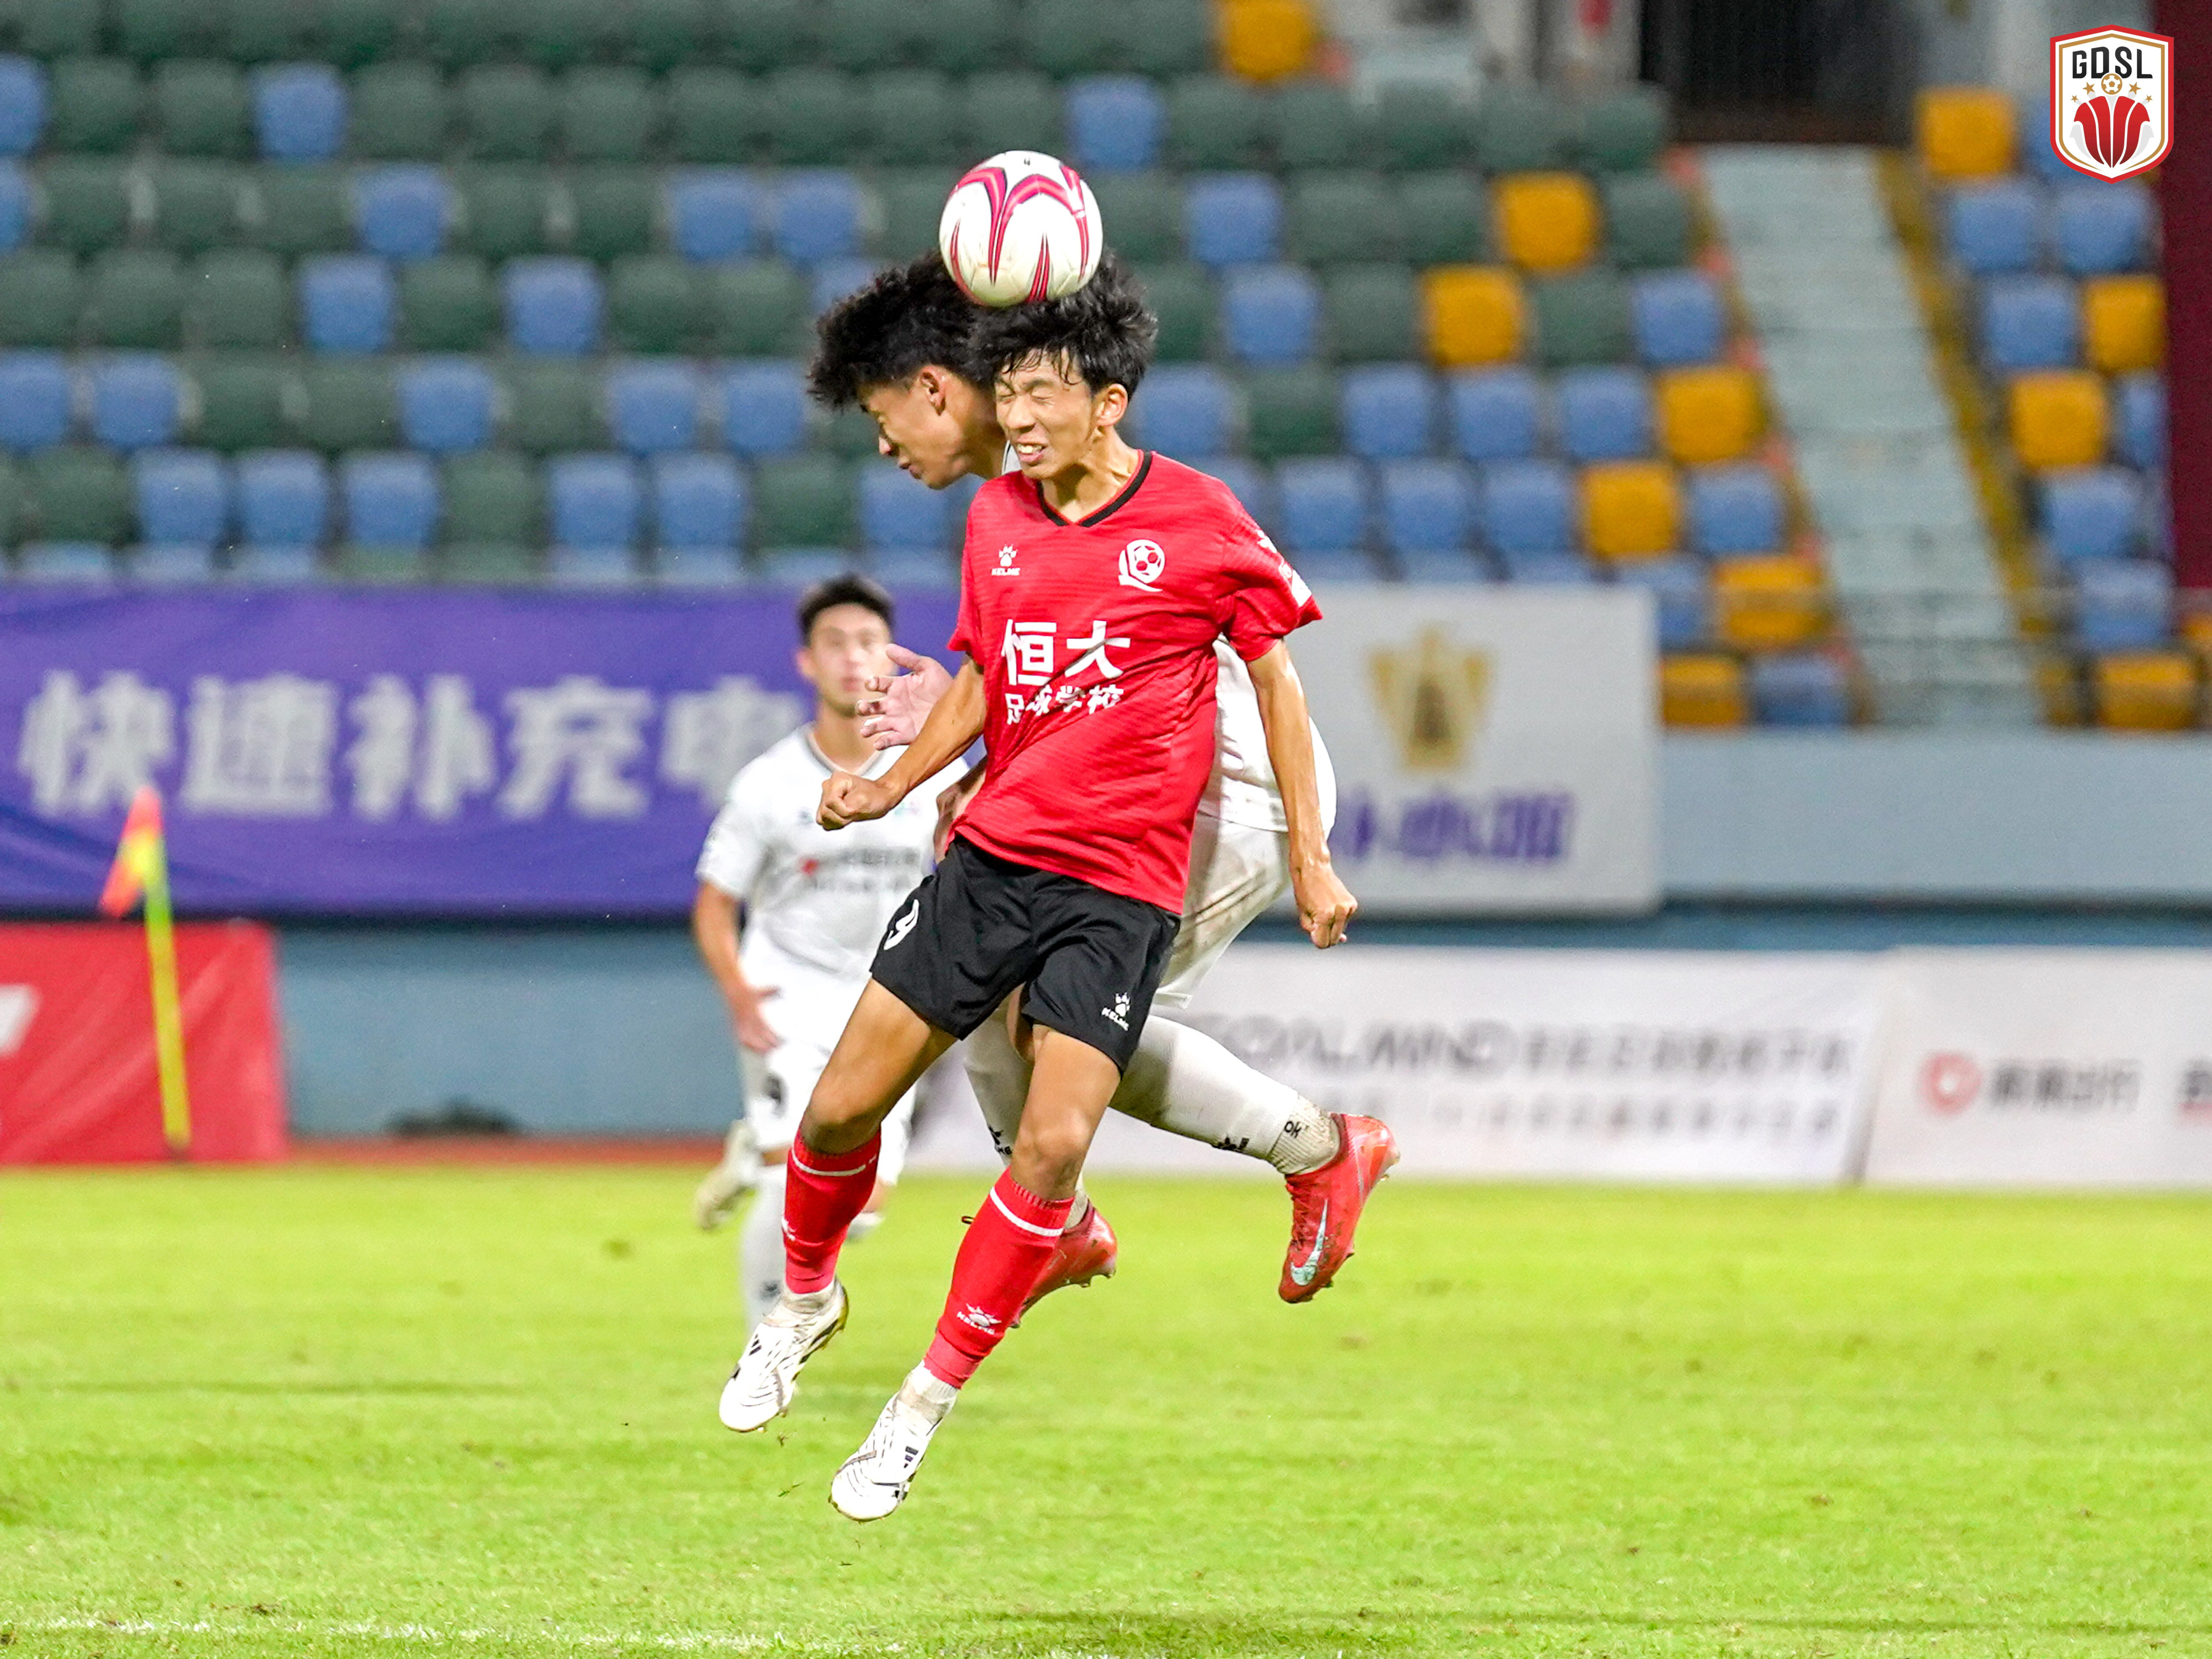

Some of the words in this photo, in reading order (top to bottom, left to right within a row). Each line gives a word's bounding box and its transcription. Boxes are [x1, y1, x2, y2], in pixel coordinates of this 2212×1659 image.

[1001, 619, 1131, 686] 恒大
[1004, 684, 1124, 725] 足球学校
